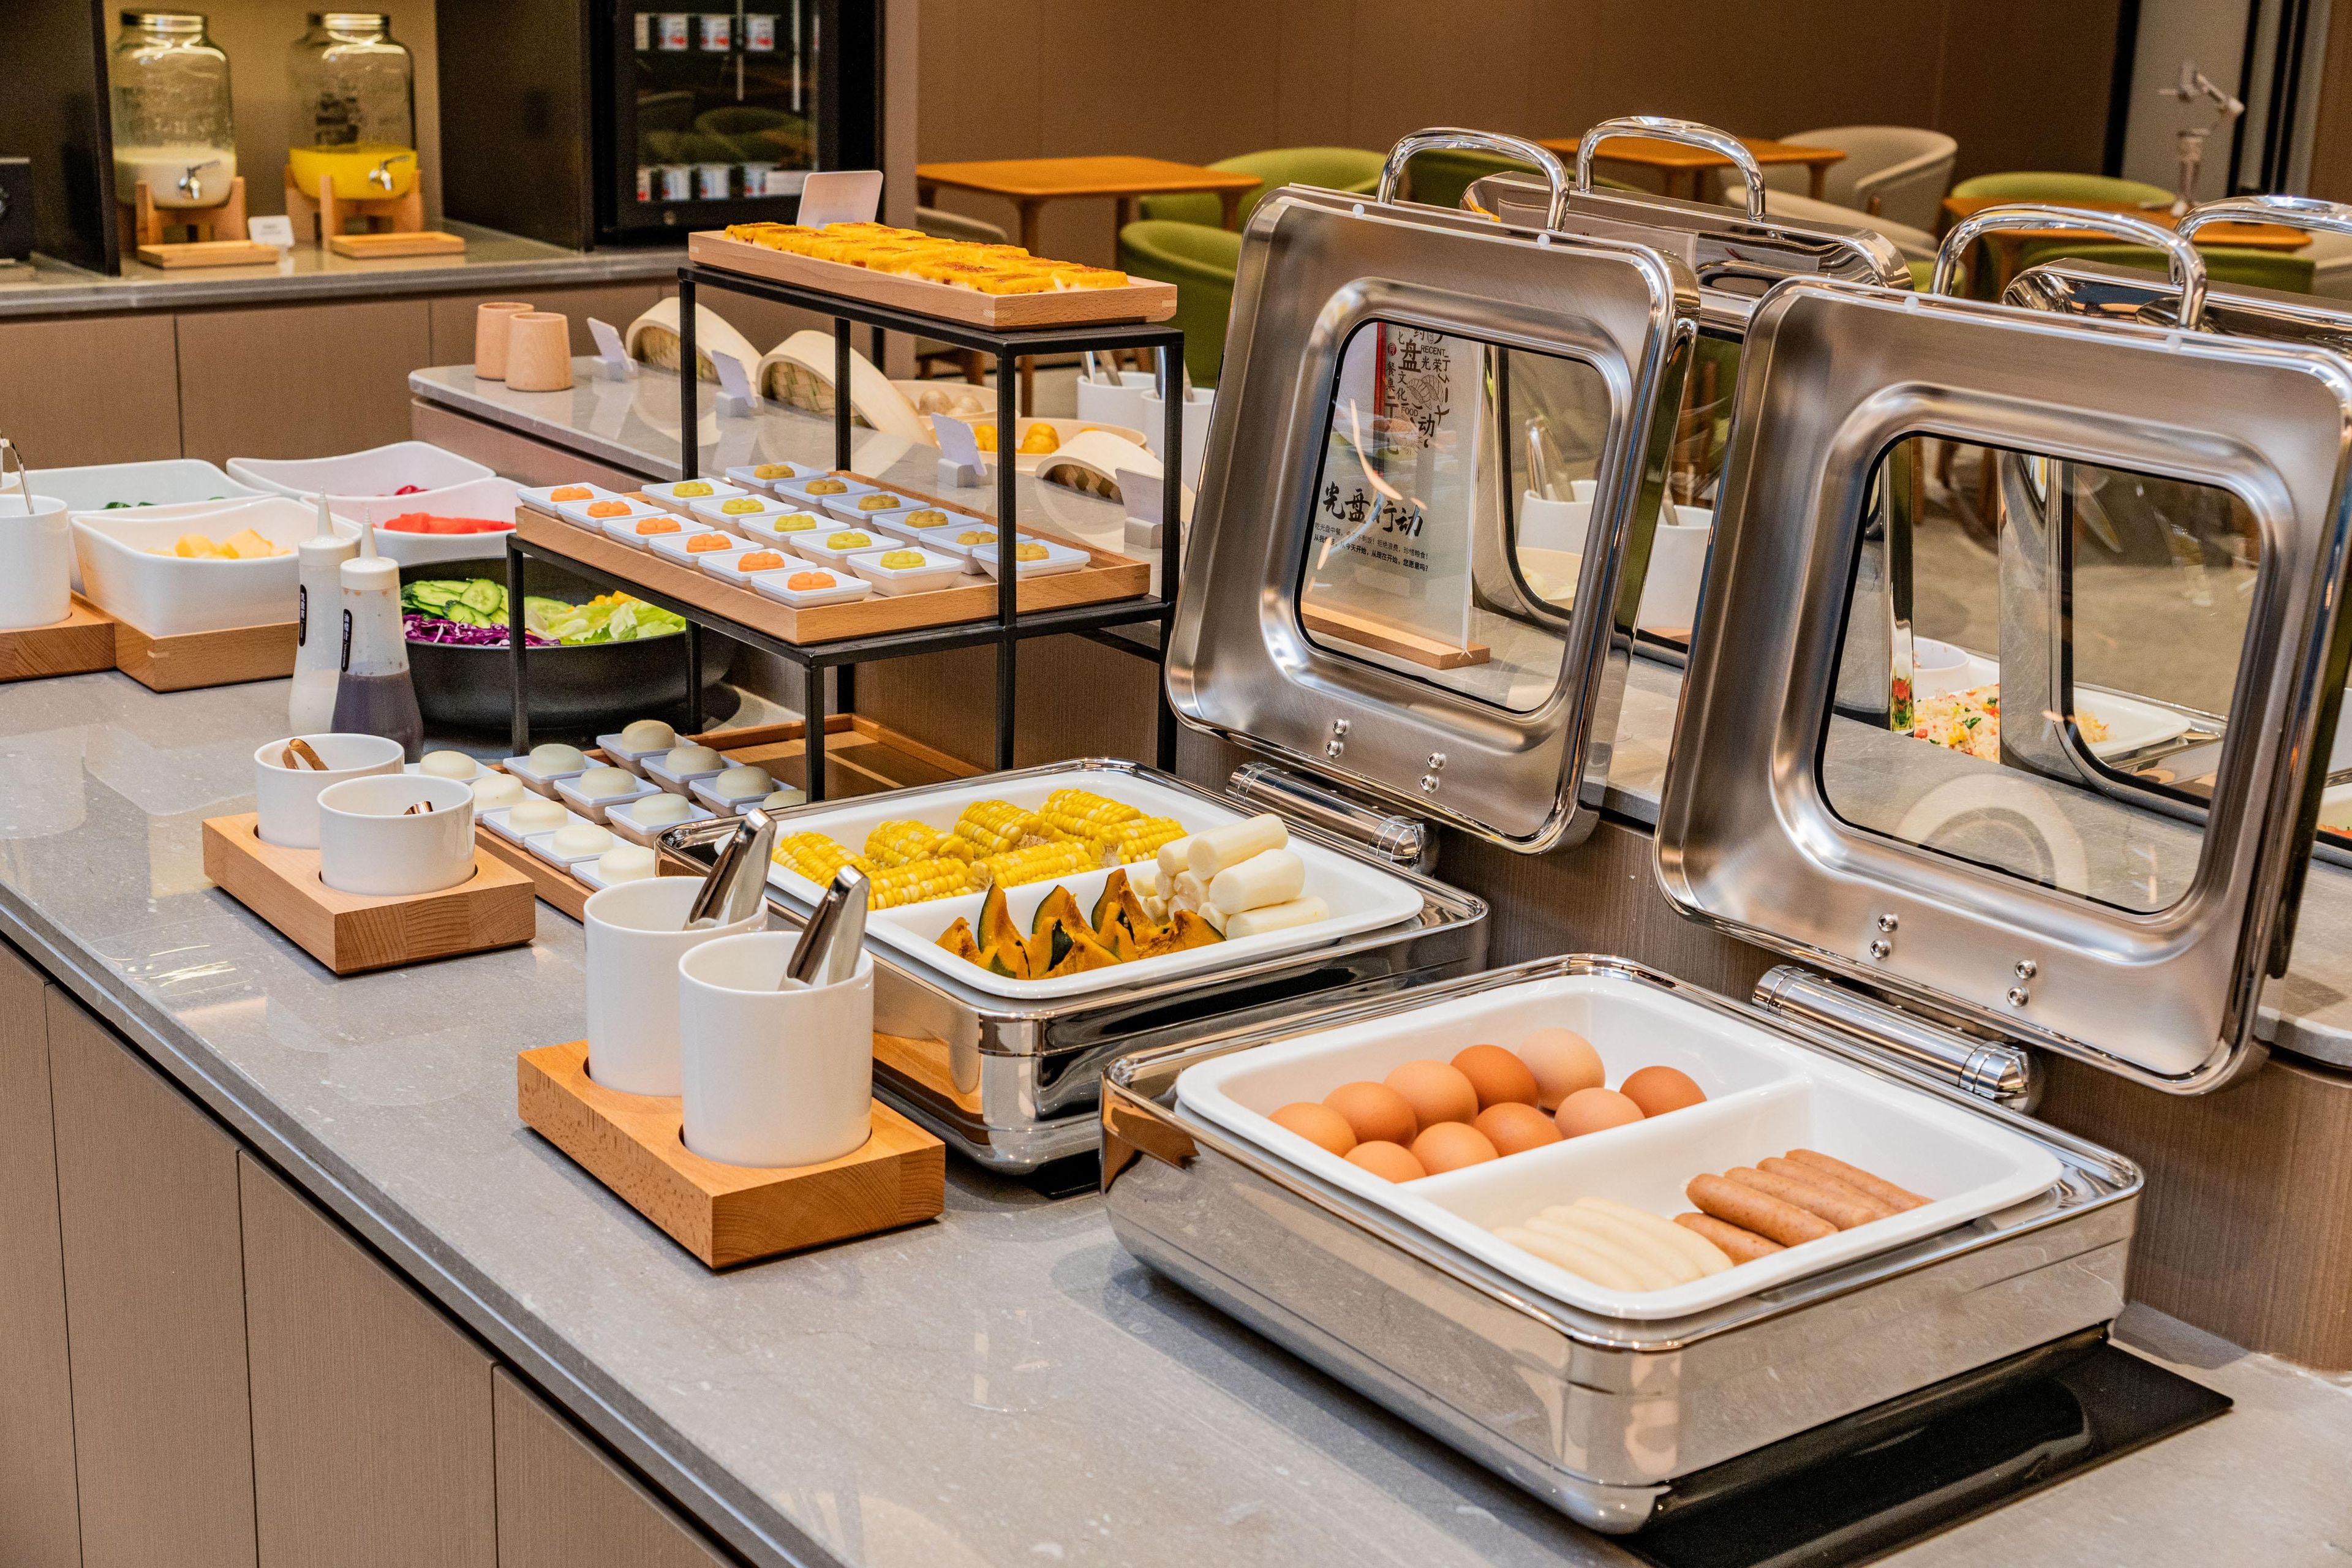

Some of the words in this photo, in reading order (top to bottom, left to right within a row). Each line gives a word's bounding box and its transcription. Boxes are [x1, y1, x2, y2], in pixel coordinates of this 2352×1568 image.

[1398, 339, 1422, 373] 盘
[1421, 344, 1446, 356] RECENT
[1421, 356, 1442, 372] 光荣
[1396, 371, 1408, 401] 文化
[1401, 406, 1419, 417] FOOD
[1418, 413, 1435, 437] 动
[1323, 481, 1423, 537] 光盘行动
